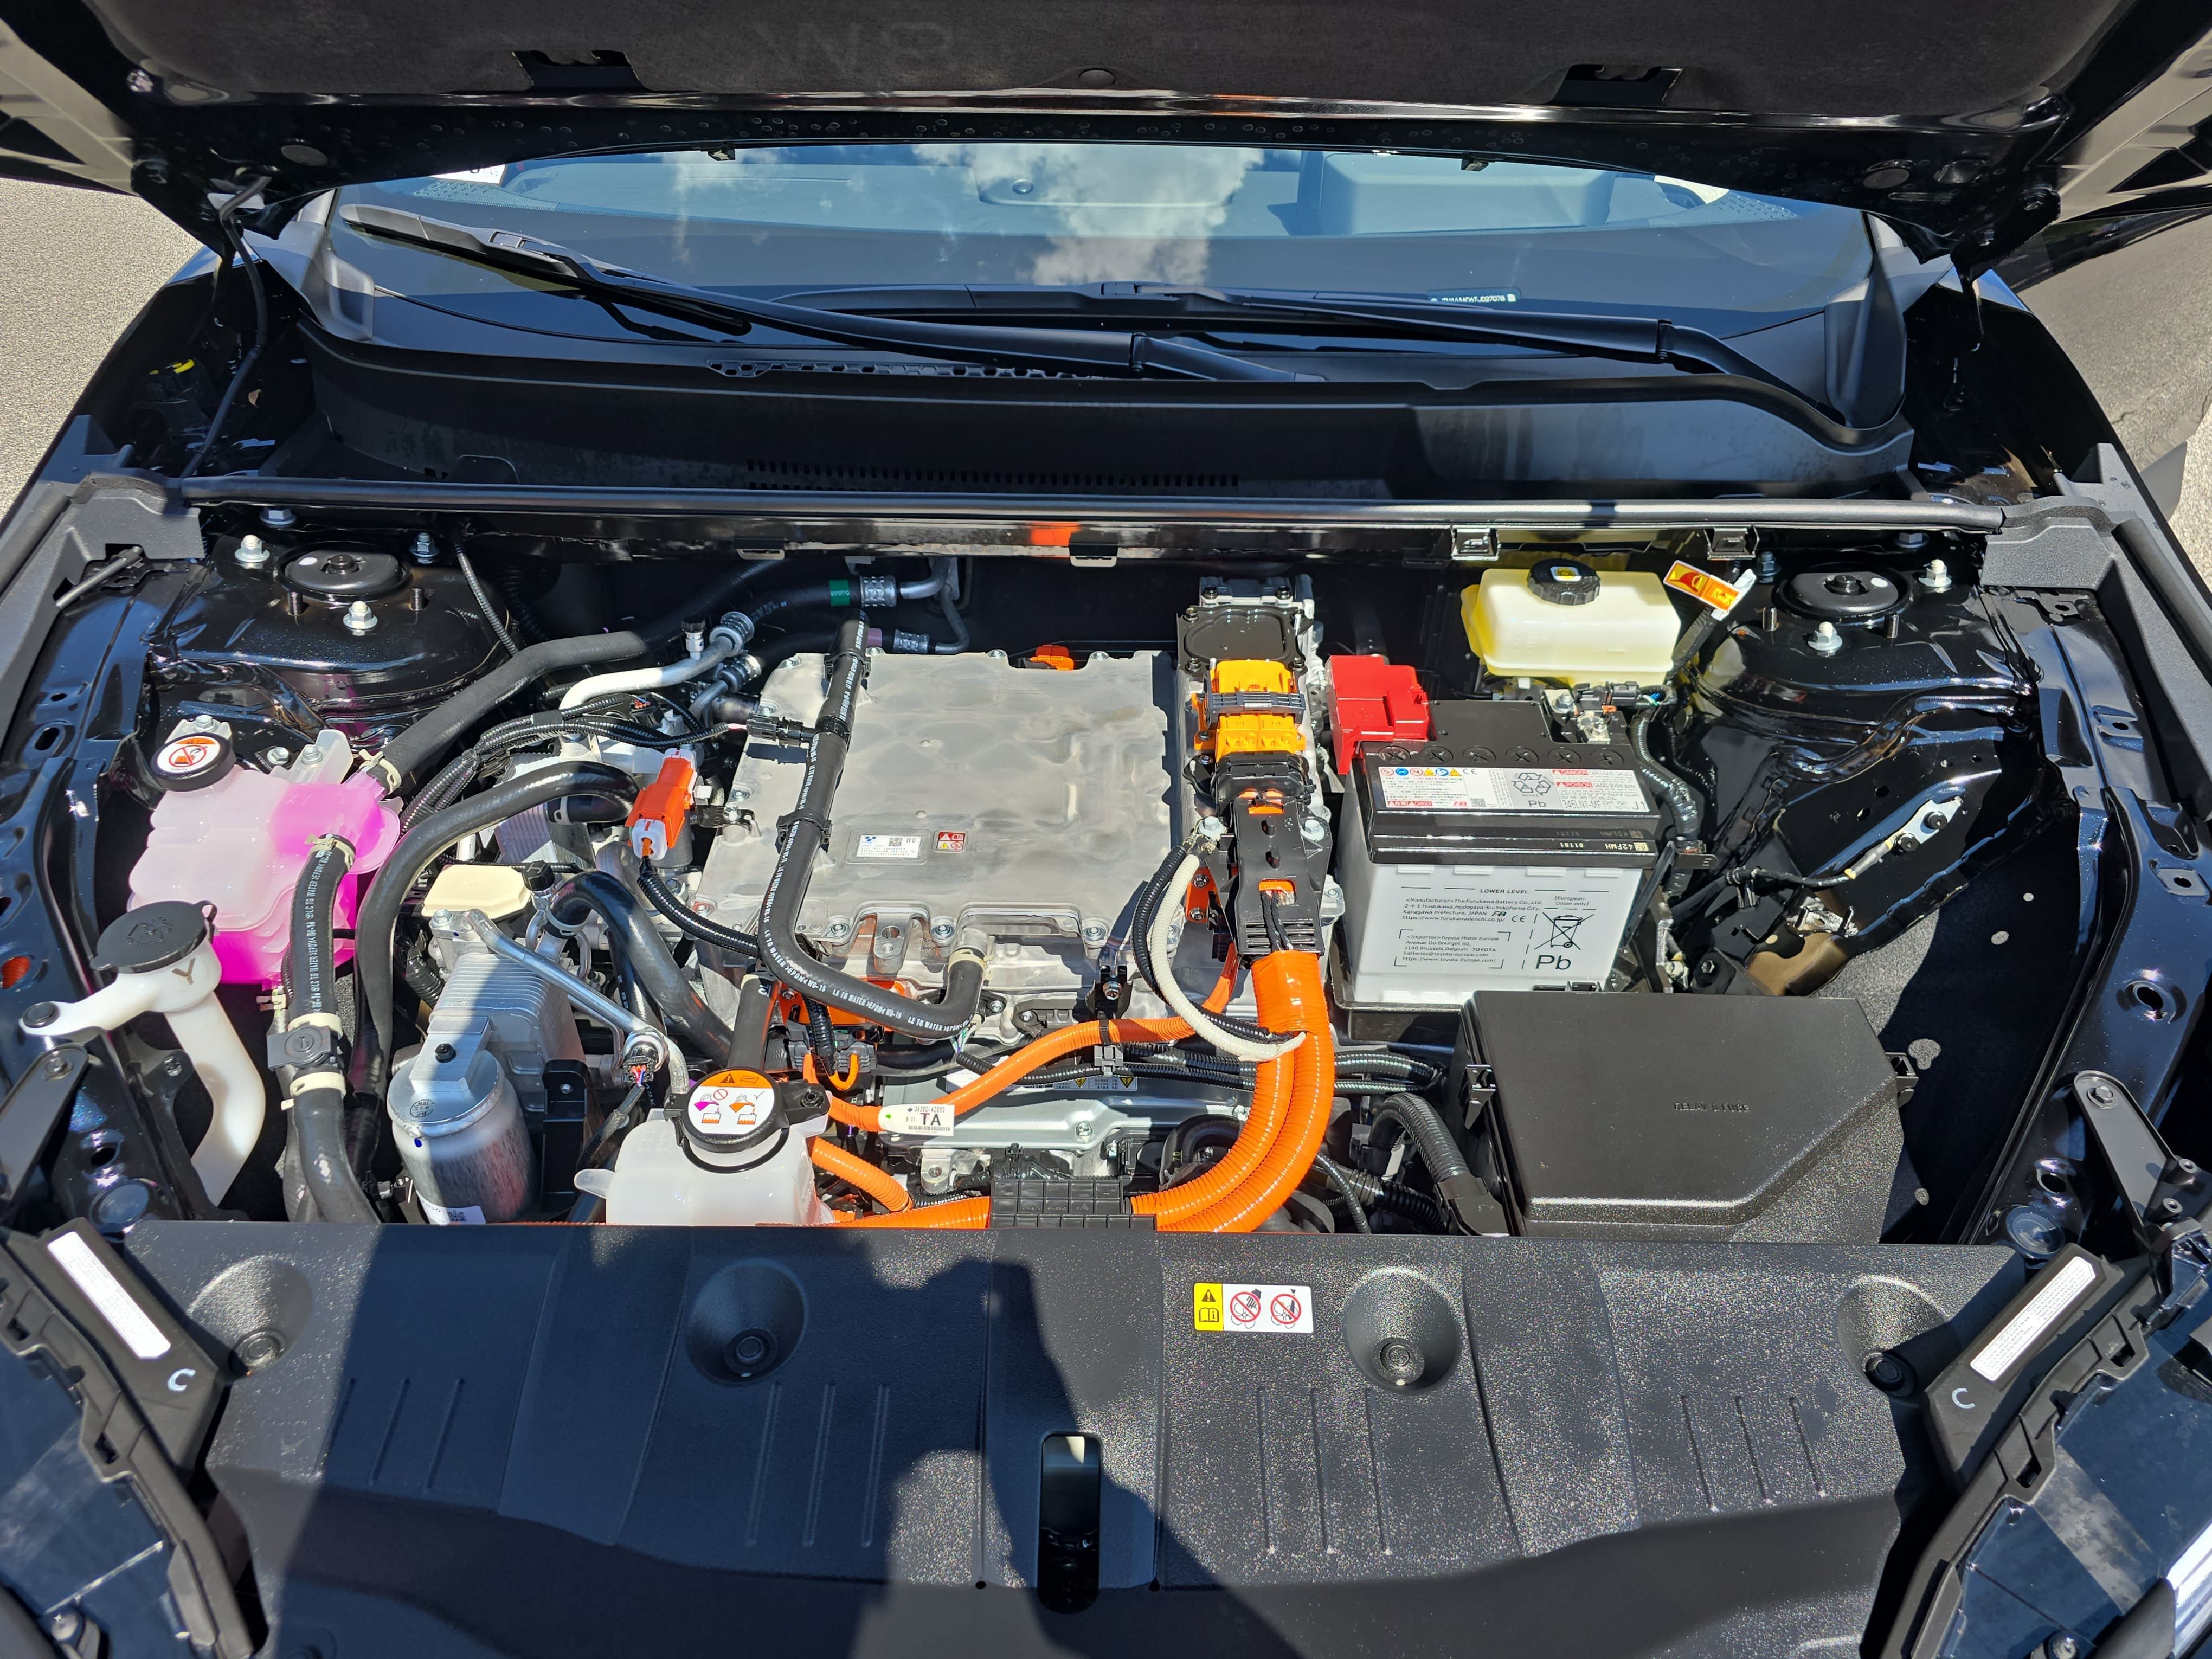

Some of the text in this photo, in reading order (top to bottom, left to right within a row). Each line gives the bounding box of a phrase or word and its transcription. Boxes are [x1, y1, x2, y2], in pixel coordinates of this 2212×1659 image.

[306, 880, 318, 897] WATER
[309, 956, 319, 972] WATER
[764, 930, 771, 938] LE
[769, 946, 786, 967] WATER
[807, 978, 827, 992] WG-15
[1535, 955, 1572, 970] Pb
[832, 988, 840, 996] LE
[848, 994, 867, 1005] WATER
[908, 1015, 916, 1024] LE
[924, 1021, 943, 1031] WATER
[1674, 1102, 1708, 1111] RELAY
[1721, 1103, 1750, 1113] FUSE
[920, 1113, 941, 1126] TA
